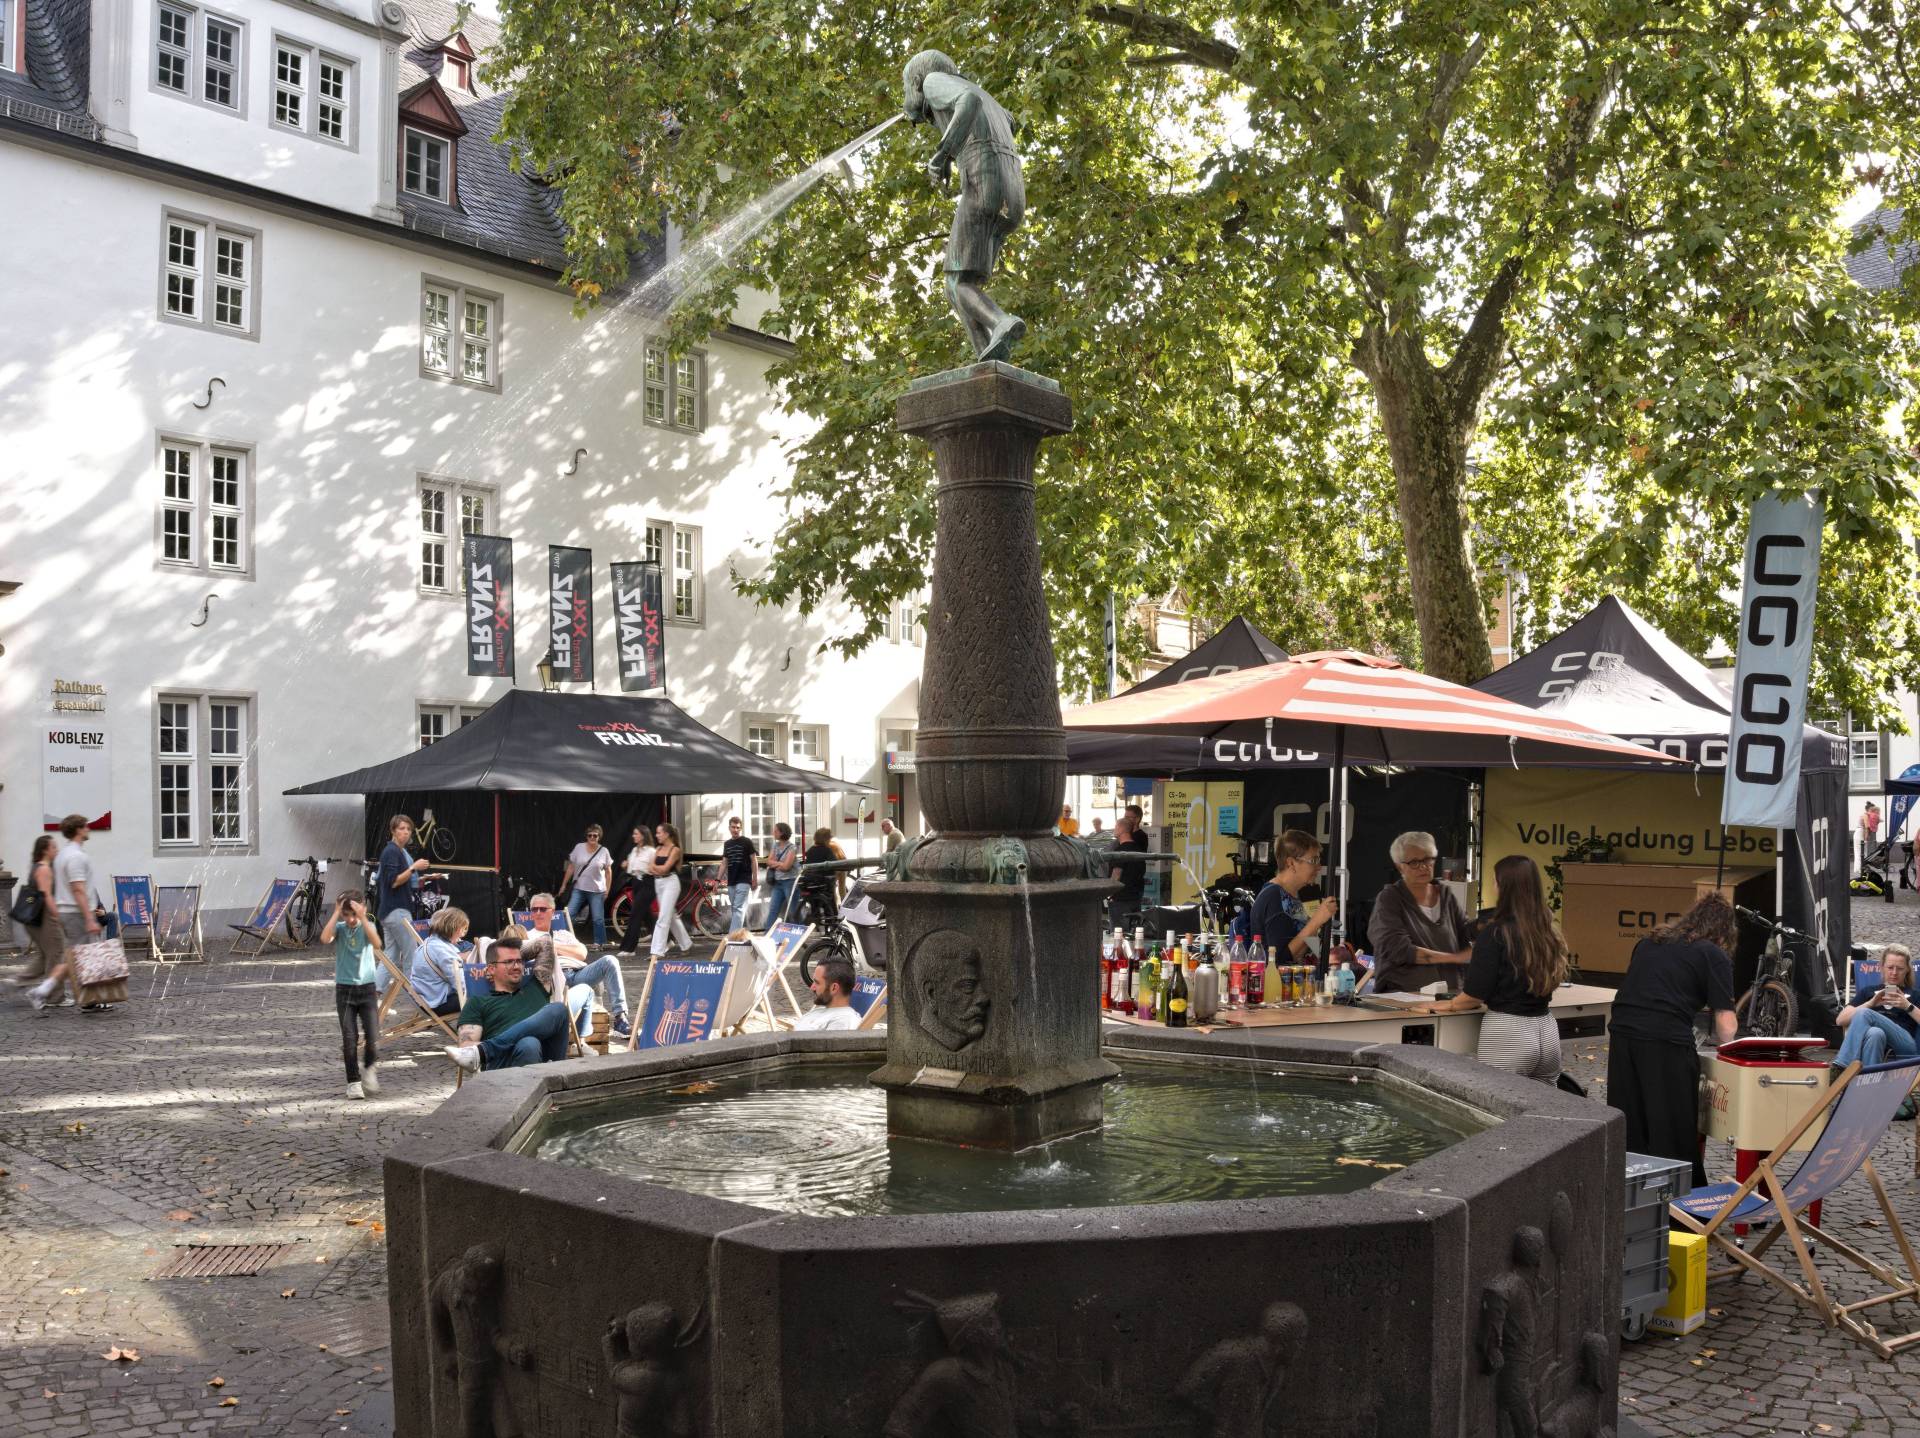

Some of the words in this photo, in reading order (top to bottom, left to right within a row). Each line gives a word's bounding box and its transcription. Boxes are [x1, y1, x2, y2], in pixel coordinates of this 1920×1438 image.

[54, 679, 105, 693] Rathaus
[48, 732, 104, 745] KOBLENZ
[594, 732, 671, 747] FRANZ
[49, 765, 78, 773] Rathaus
[1517, 823, 1581, 845] Volle
[1590, 825, 1694, 855] Ladung
[1704, 829, 1775, 854] Lebe
[693, 963, 725, 974] Atelier
